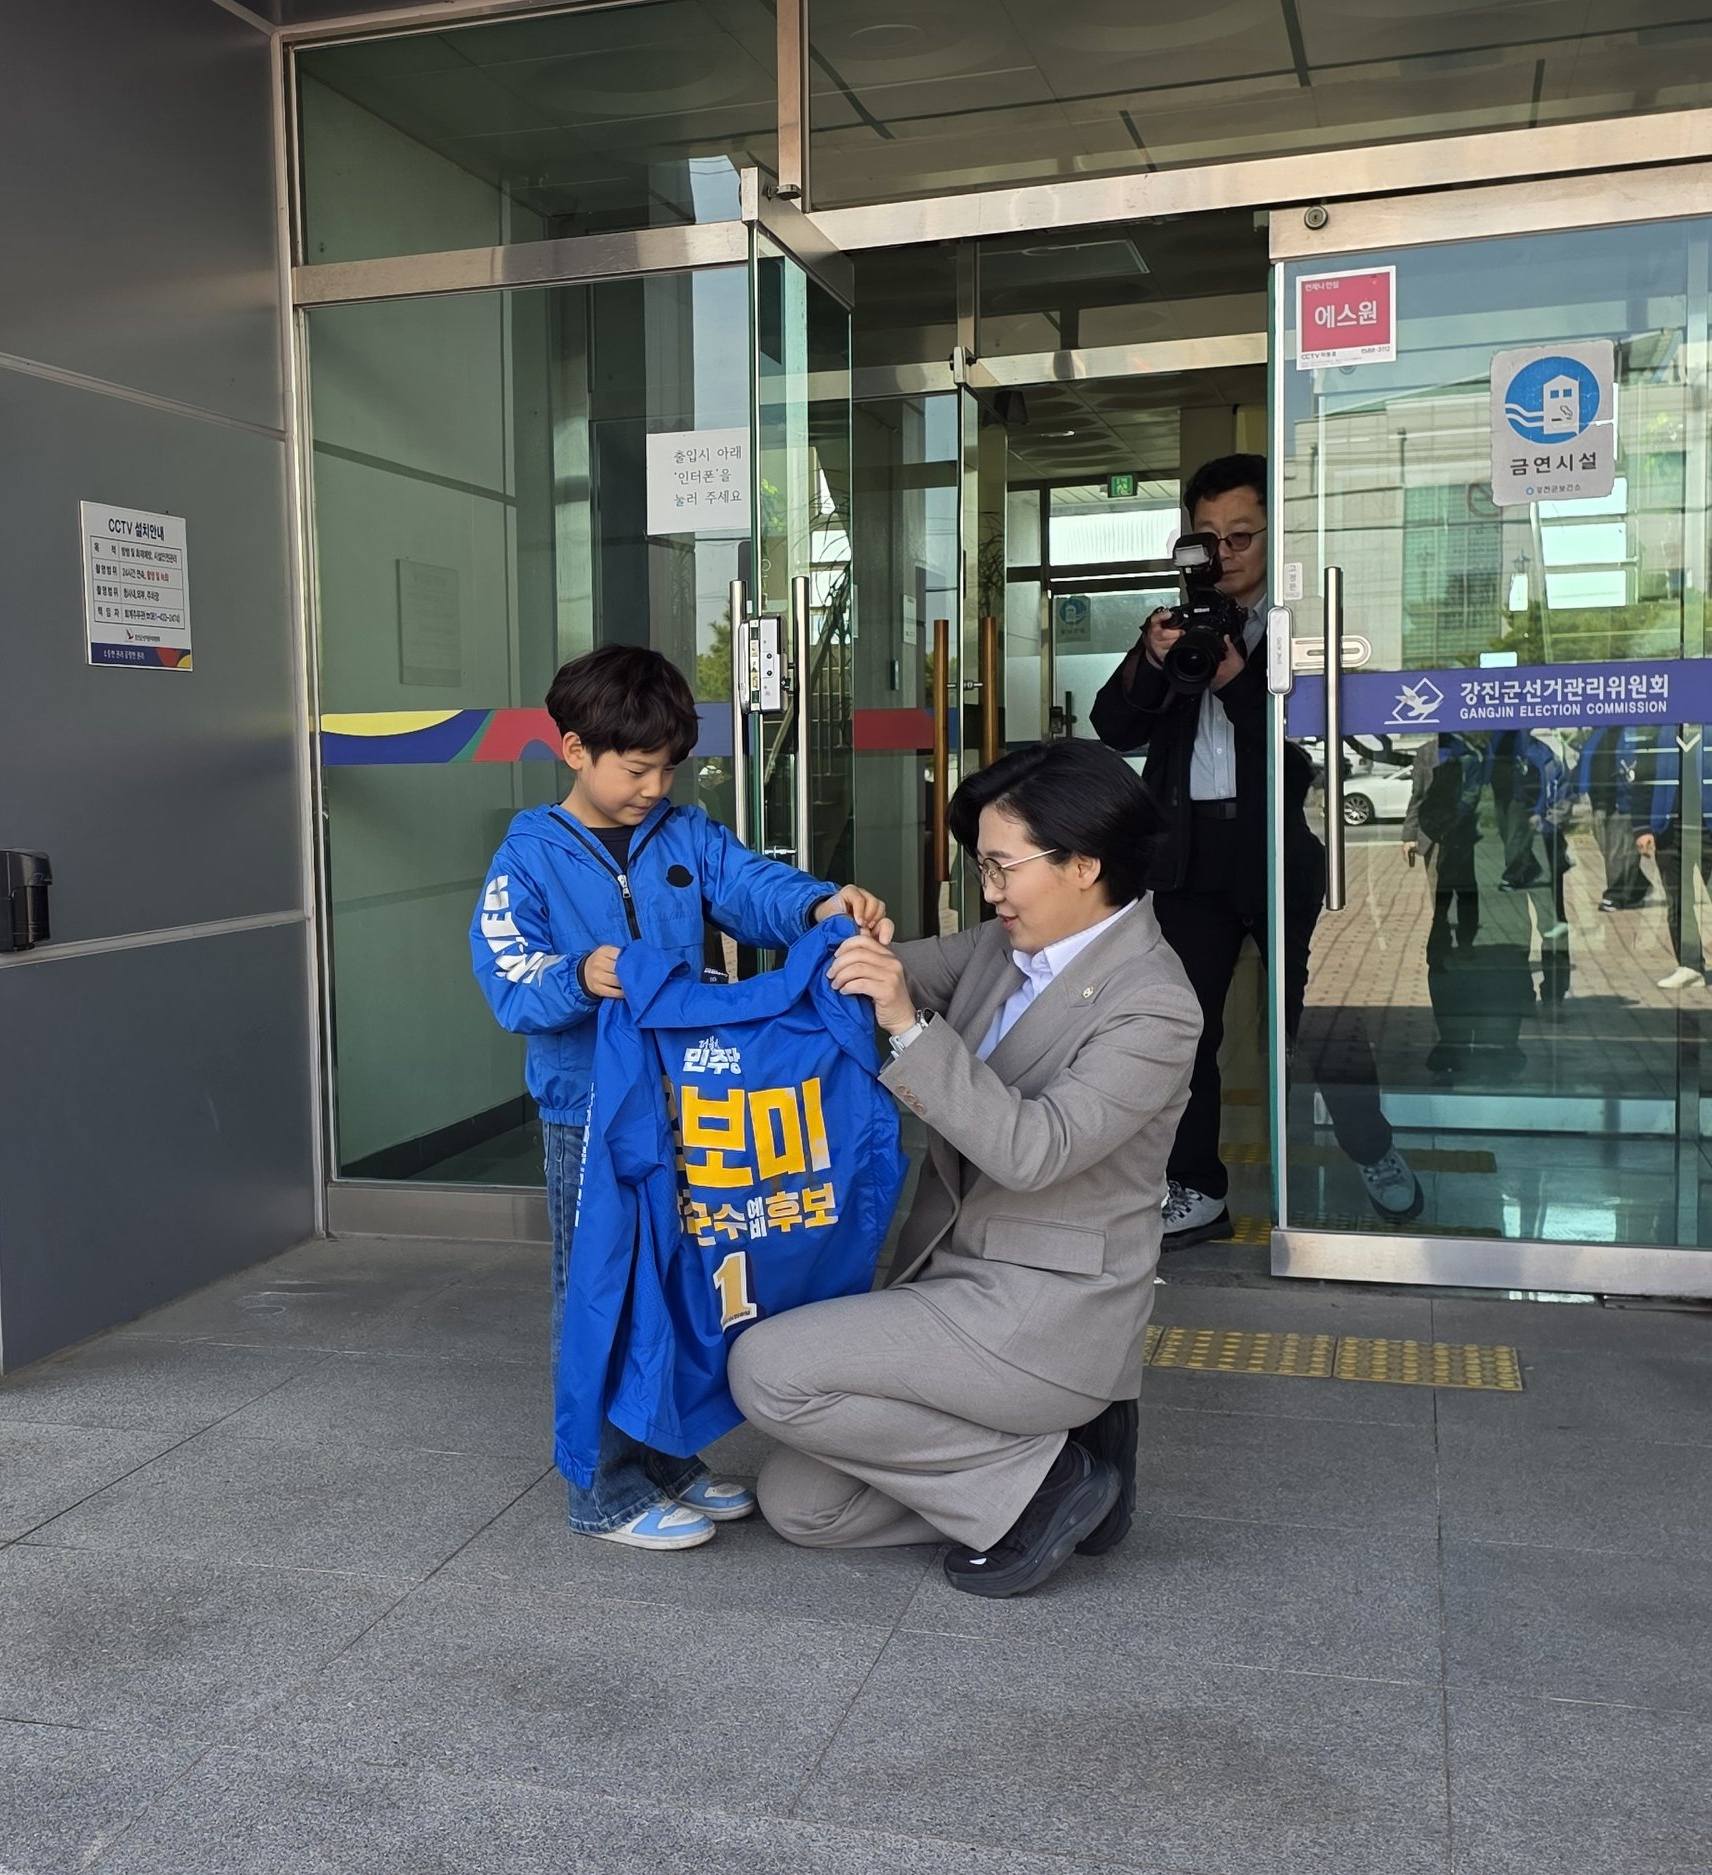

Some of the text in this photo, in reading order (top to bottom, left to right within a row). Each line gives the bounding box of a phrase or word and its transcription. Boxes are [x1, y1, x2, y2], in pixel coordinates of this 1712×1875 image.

[1314, 300, 1377, 328] 에스원
[674, 446, 742, 464] 출입시 아래
[1510, 451, 1597, 476] 금연시설
[674, 490, 742, 507] 눌러 주세요
[108, 518, 165, 541] CCTV 설치안내
[1460, 674, 1669, 705] 강진군선거관리위원회
[1460, 701, 1667, 720] GANGJIN ELECTION COMMISSION
[683, 1047, 742, 1075] 민주당
[664, 1077, 831, 1187] 보미
[677, 1190, 748, 1246] 군수
[712, 1251, 757, 1332] 1
